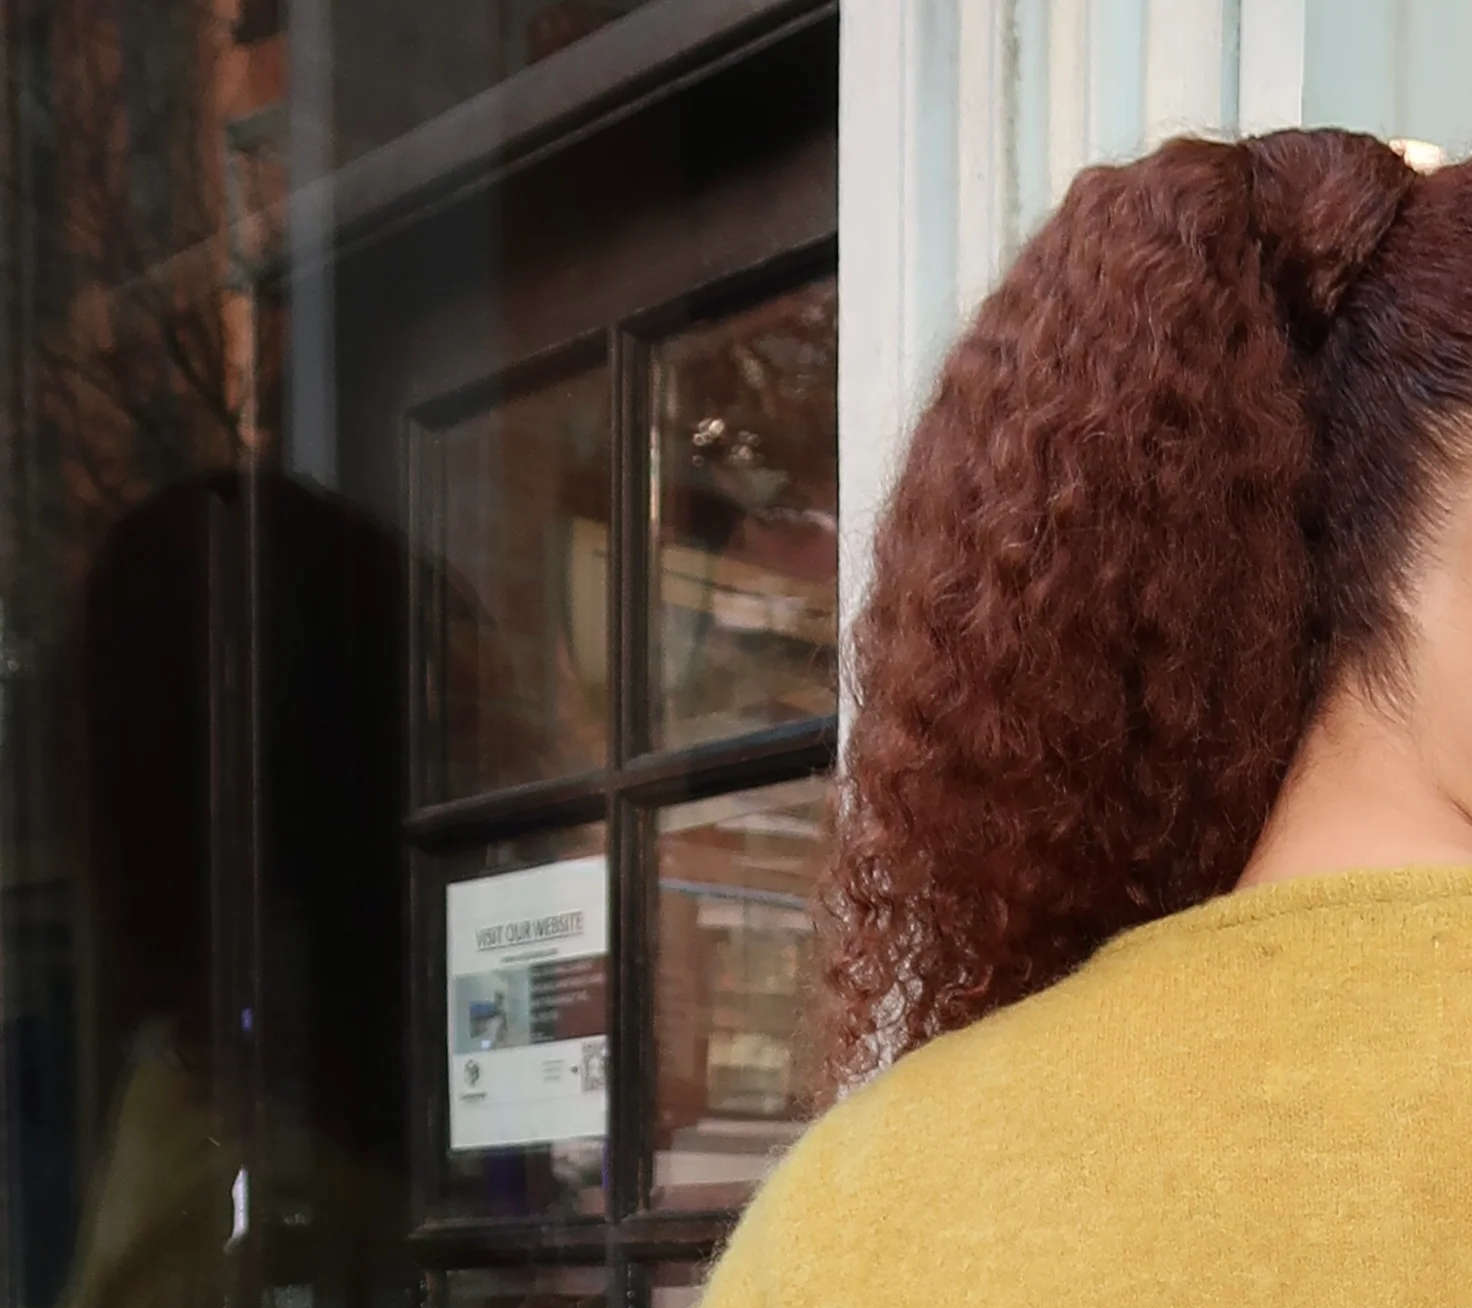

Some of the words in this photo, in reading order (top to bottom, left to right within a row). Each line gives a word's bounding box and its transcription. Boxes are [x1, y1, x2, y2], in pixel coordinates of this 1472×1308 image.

[476, 926, 502, 947] VISIT
[505, 920, 531, 943] OUR
[533, 911, 583, 940] WEBSITE
